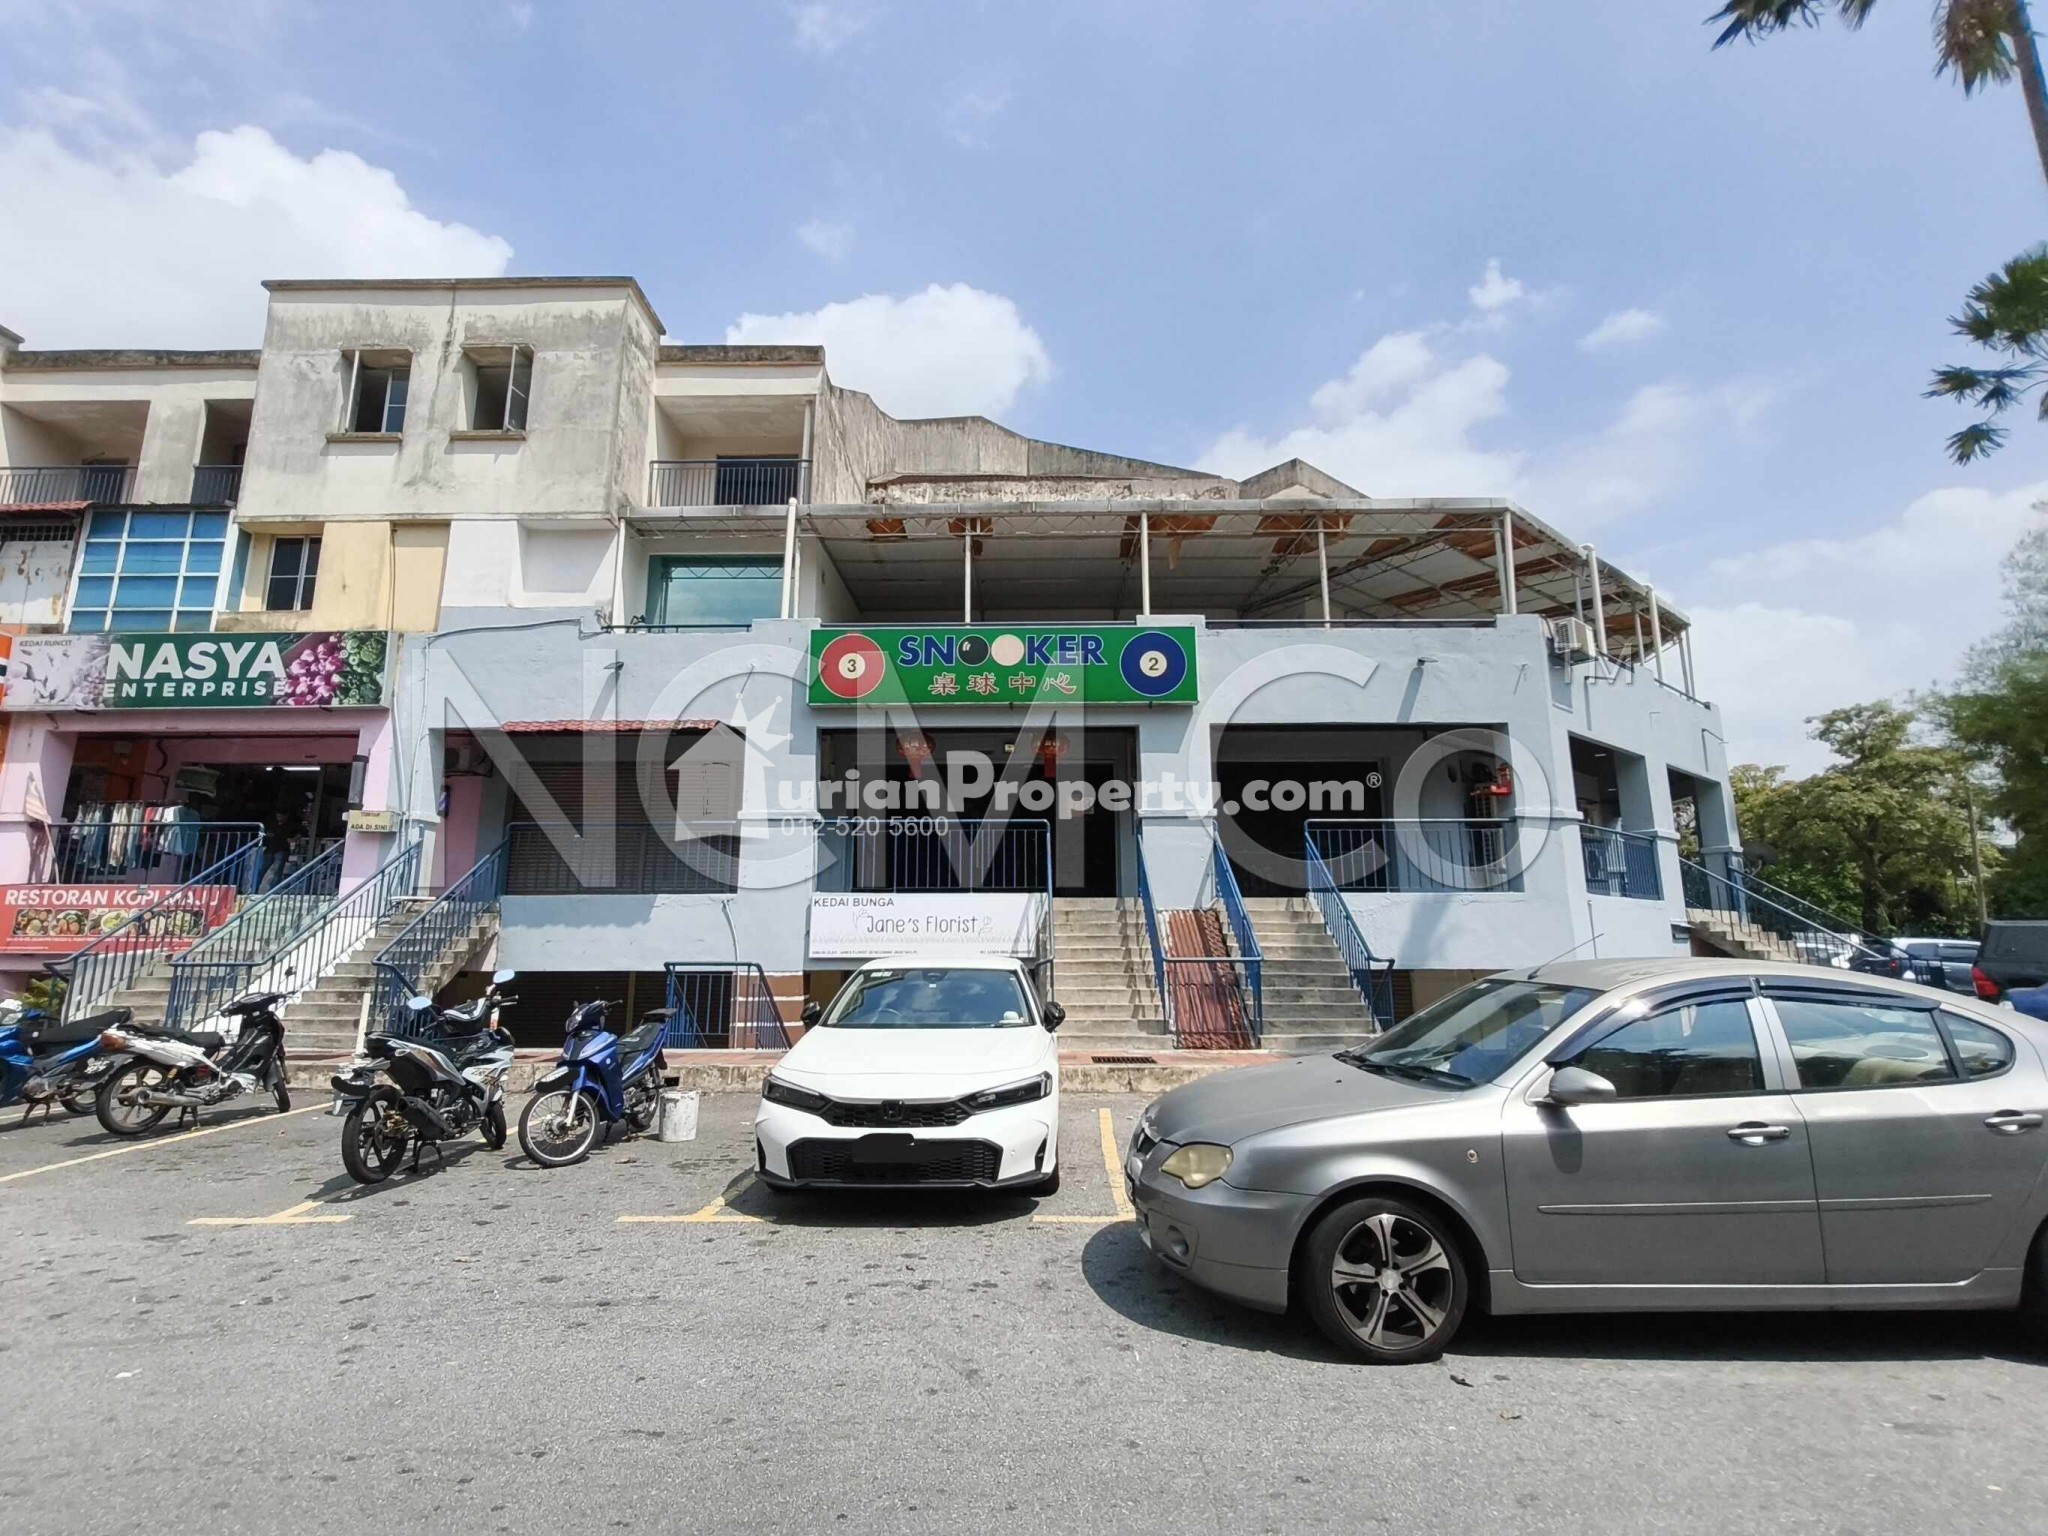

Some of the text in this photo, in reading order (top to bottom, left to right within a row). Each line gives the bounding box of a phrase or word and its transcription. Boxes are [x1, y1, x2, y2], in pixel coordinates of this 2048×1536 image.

[19, 639, 73, 647] KEDAI RUNCIT
[897, 633, 1107, 667] SNOOKER
[105, 641, 287, 681] NASYA
[846, 658, 858, 674] 3
[1147, 656, 1160, 672] 2
[102, 681, 289, 698] ENTERPRISE
[5, 889, 108, 906] RESTORAN
[113, 889, 160, 906] KOPI
[813, 897, 895, 908] KEDAI BUNGA
[866, 914, 978, 934] Jane's Florist
